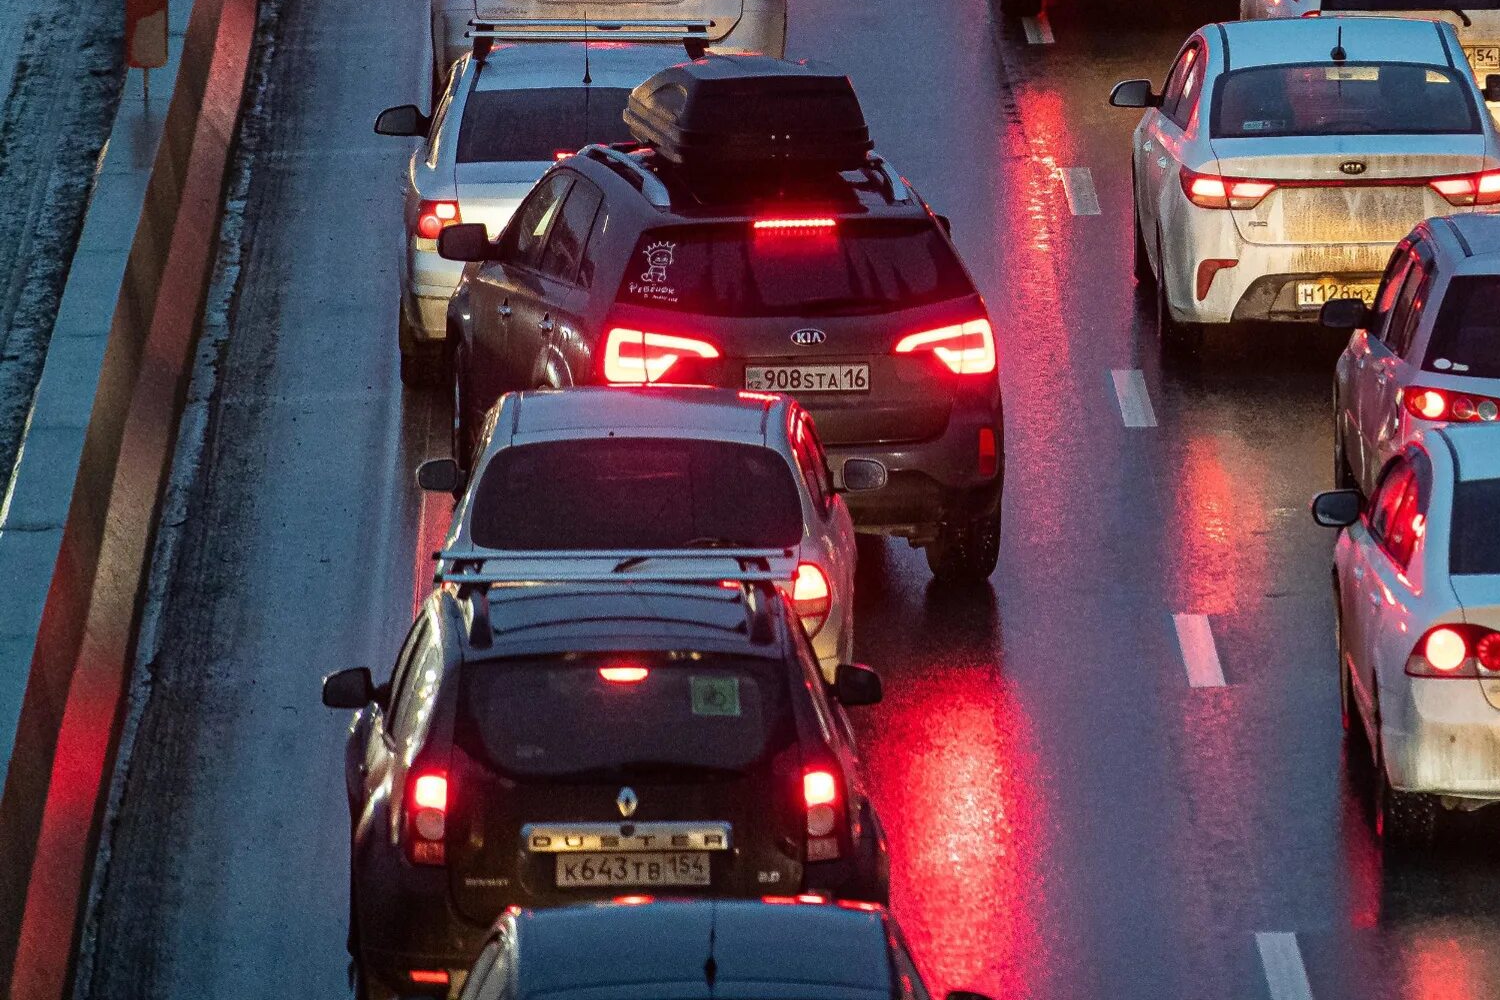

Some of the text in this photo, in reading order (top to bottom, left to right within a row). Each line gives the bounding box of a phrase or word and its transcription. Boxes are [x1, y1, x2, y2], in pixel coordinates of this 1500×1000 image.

[1475, 48, 1494, 62] 54
[1343, 163, 1364, 172] KIA
[796, 332, 822, 344] KIA
[747, 380, 763, 390] KZ
[763, 367, 866, 390] 908STA 16
[532, 834, 724, 849] DUSTER
[564, 855, 704, 881] К643ТВ 154
